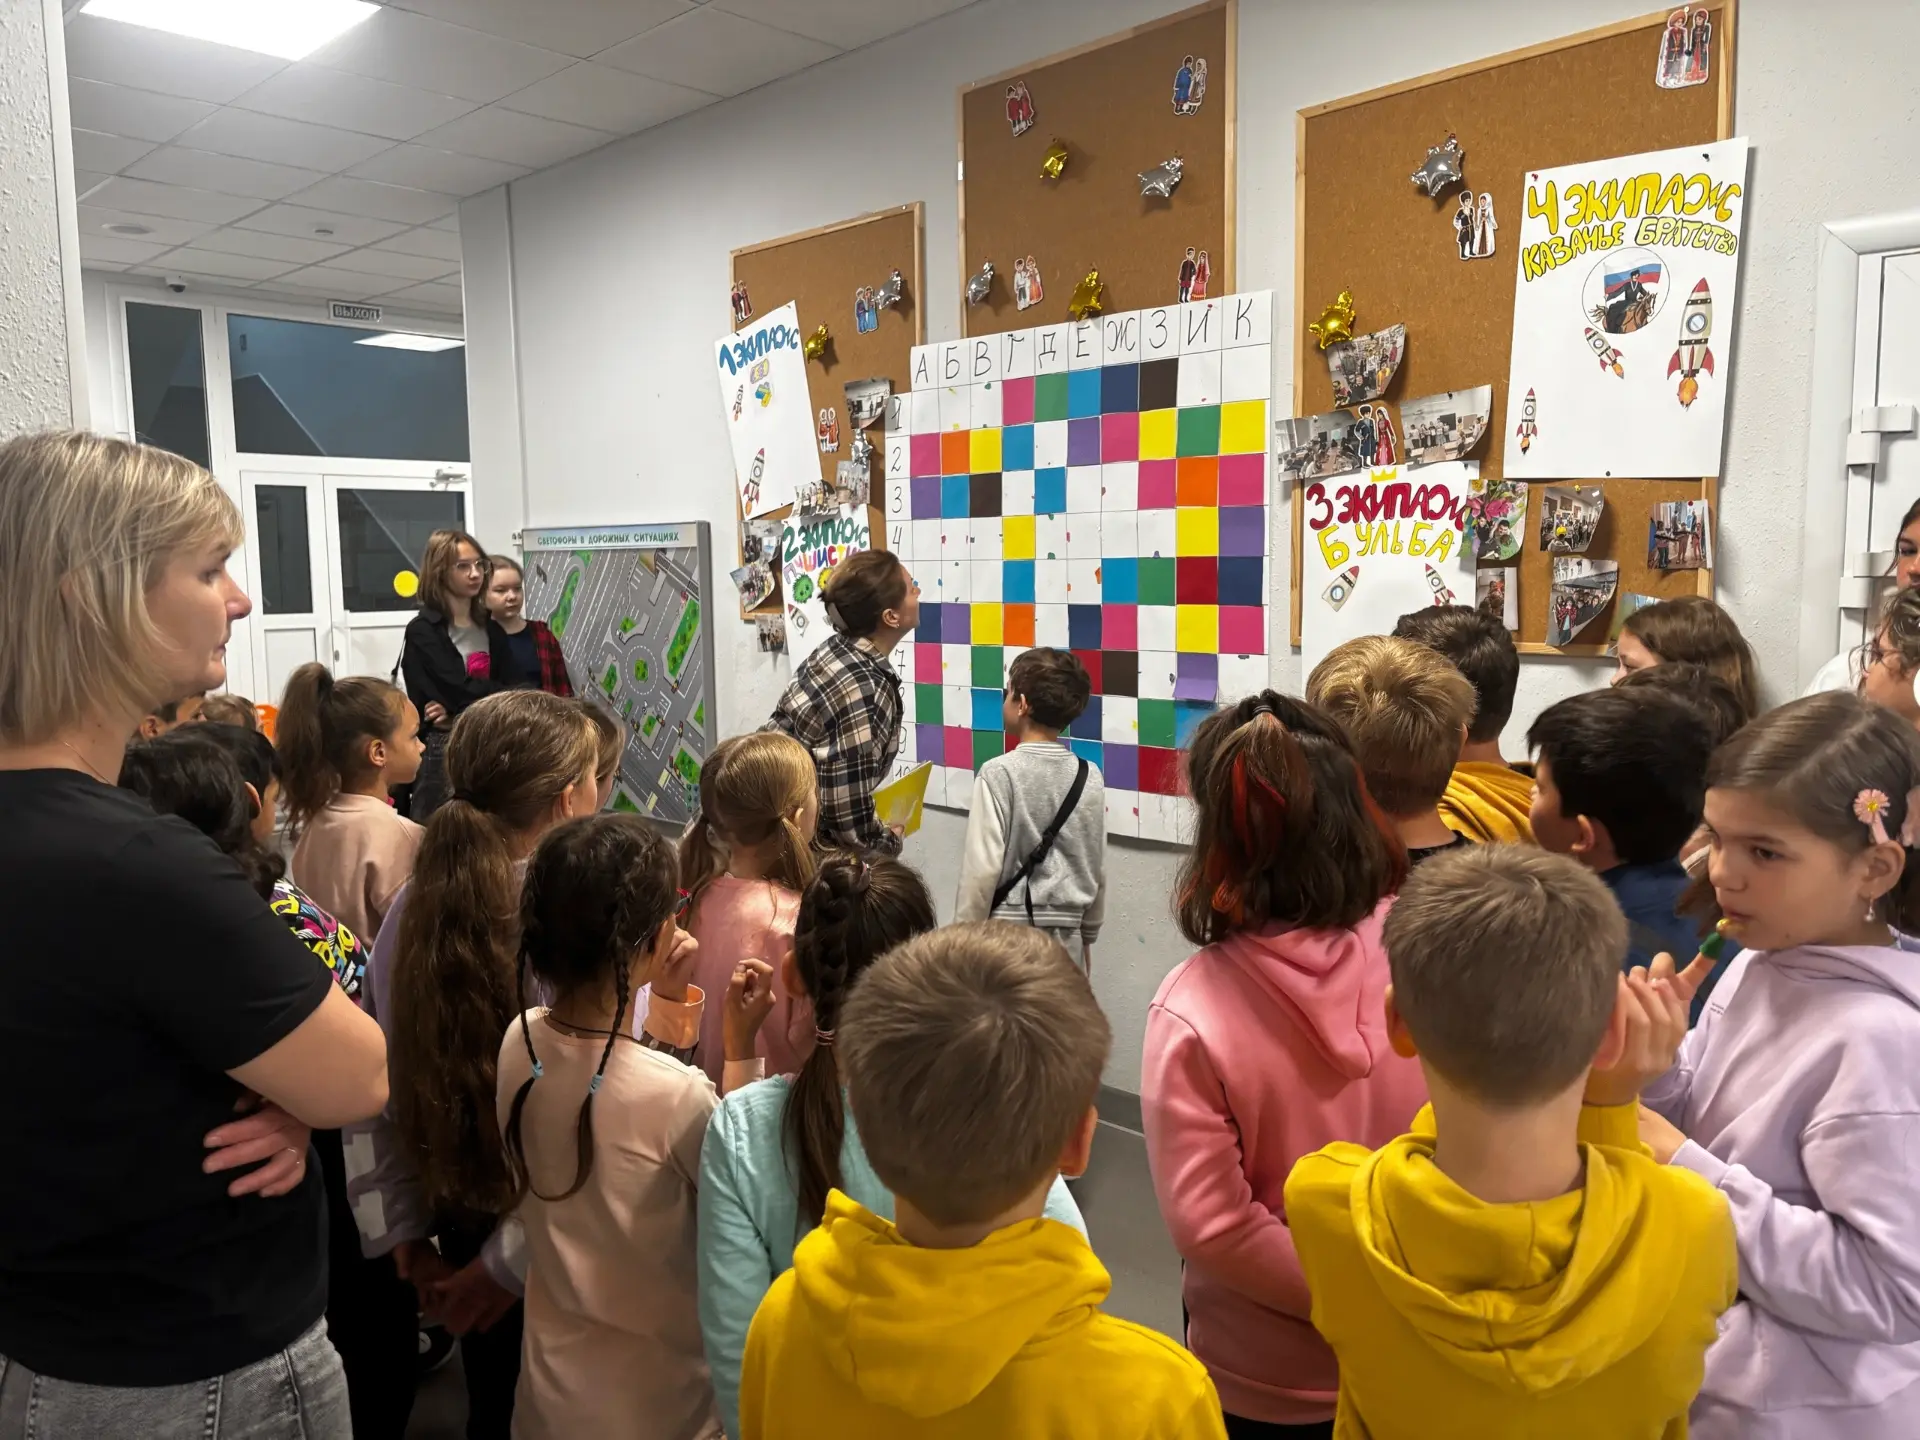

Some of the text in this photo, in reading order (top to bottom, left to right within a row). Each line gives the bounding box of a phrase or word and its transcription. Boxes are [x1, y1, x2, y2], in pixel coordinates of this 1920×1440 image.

[1564, 172, 1742, 228] ЭКИПАЖ
[1522, 216, 1738, 282] КАЗАЧЬЕ БРАТСТВО
[719, 343, 737, 376] 1
[733, 324, 799, 369] ЭКИПАЖ
[915, 353, 929, 383] А
[945, 345, 961, 379] Б
[974, 341, 992, 377] В
[1007, 335, 1025, 373] Г
[1038, 332, 1057, 369] Д
[1076, 325, 1091, 358] Е
[1106, 317, 1136, 352] Ж
[1187, 308, 1211, 346] И
[1234, 298, 1253, 341] К
[891, 397, 902, 430] 1
[890, 446, 902, 472] 2
[892, 486, 903, 514] 3
[537, 532, 680, 545] СВЕТОФОРЫ В ДОРОЖНЫХ СИТУАЦИЯХ
[783, 516, 869, 563] 2 ЭКИПАЖ
[892, 526, 903, 555] 4
[1317, 521, 1454, 571] БУЛЬБА
[895, 649, 906, 676] 7
